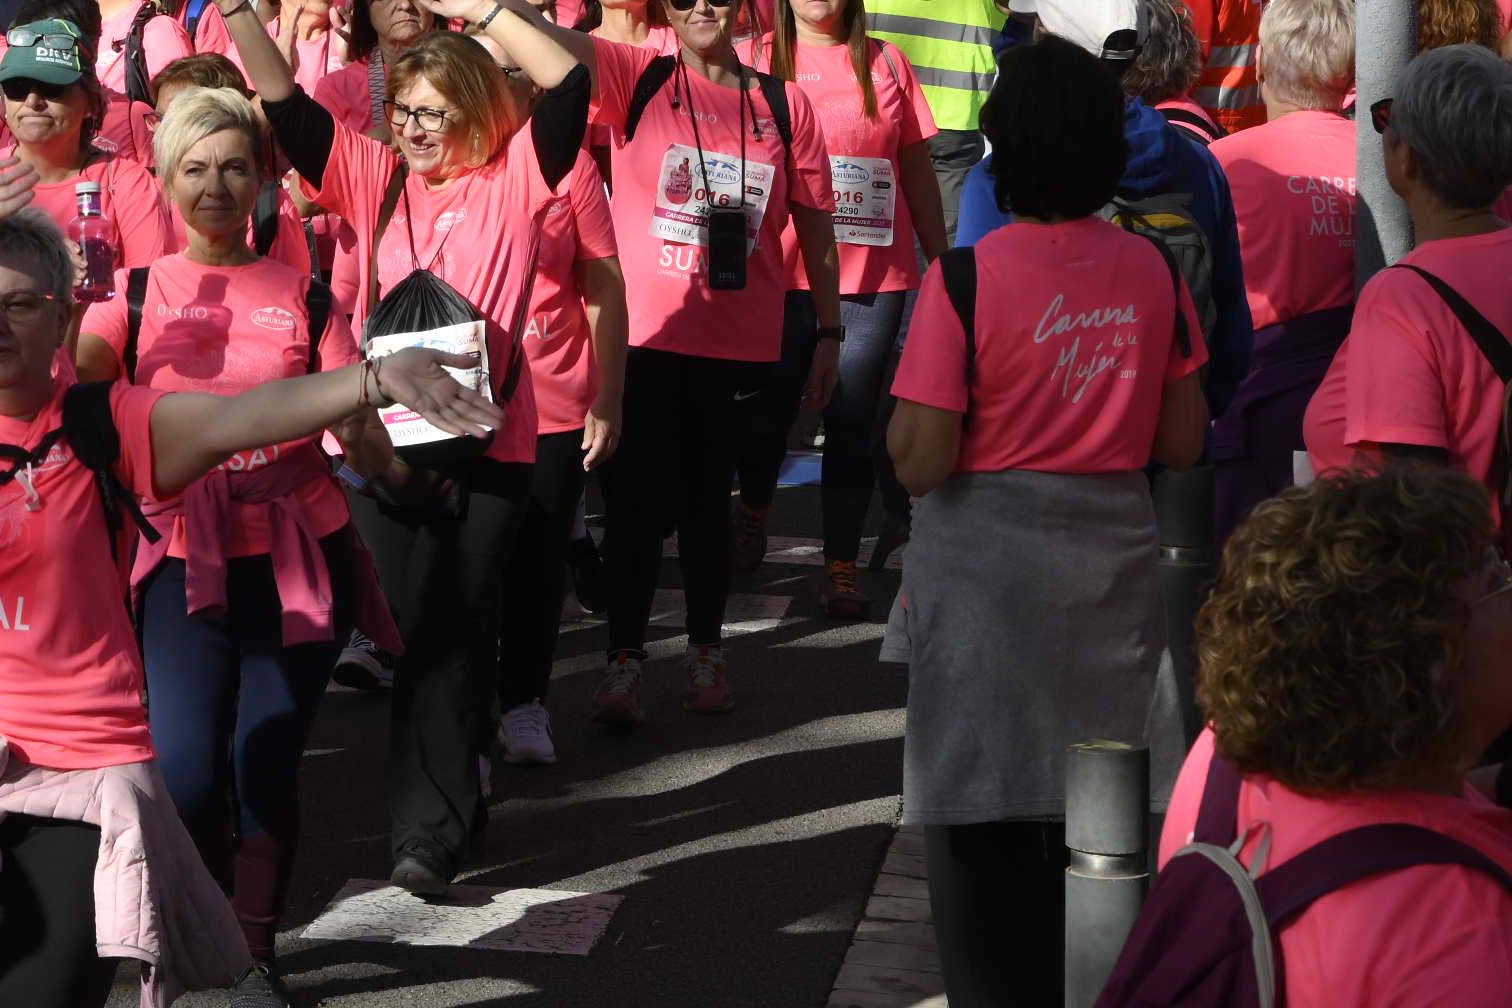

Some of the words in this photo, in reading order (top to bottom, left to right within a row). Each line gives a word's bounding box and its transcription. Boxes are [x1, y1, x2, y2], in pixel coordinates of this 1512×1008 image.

[795, 72, 822, 82] SHO
[833, 191, 864, 204] 016
[1311, 196, 1340, 215] DE
[659, 243, 700, 272] SU
[1034, 293, 1141, 344] Carrera
[1050, 336, 1122, 404] Mujer
